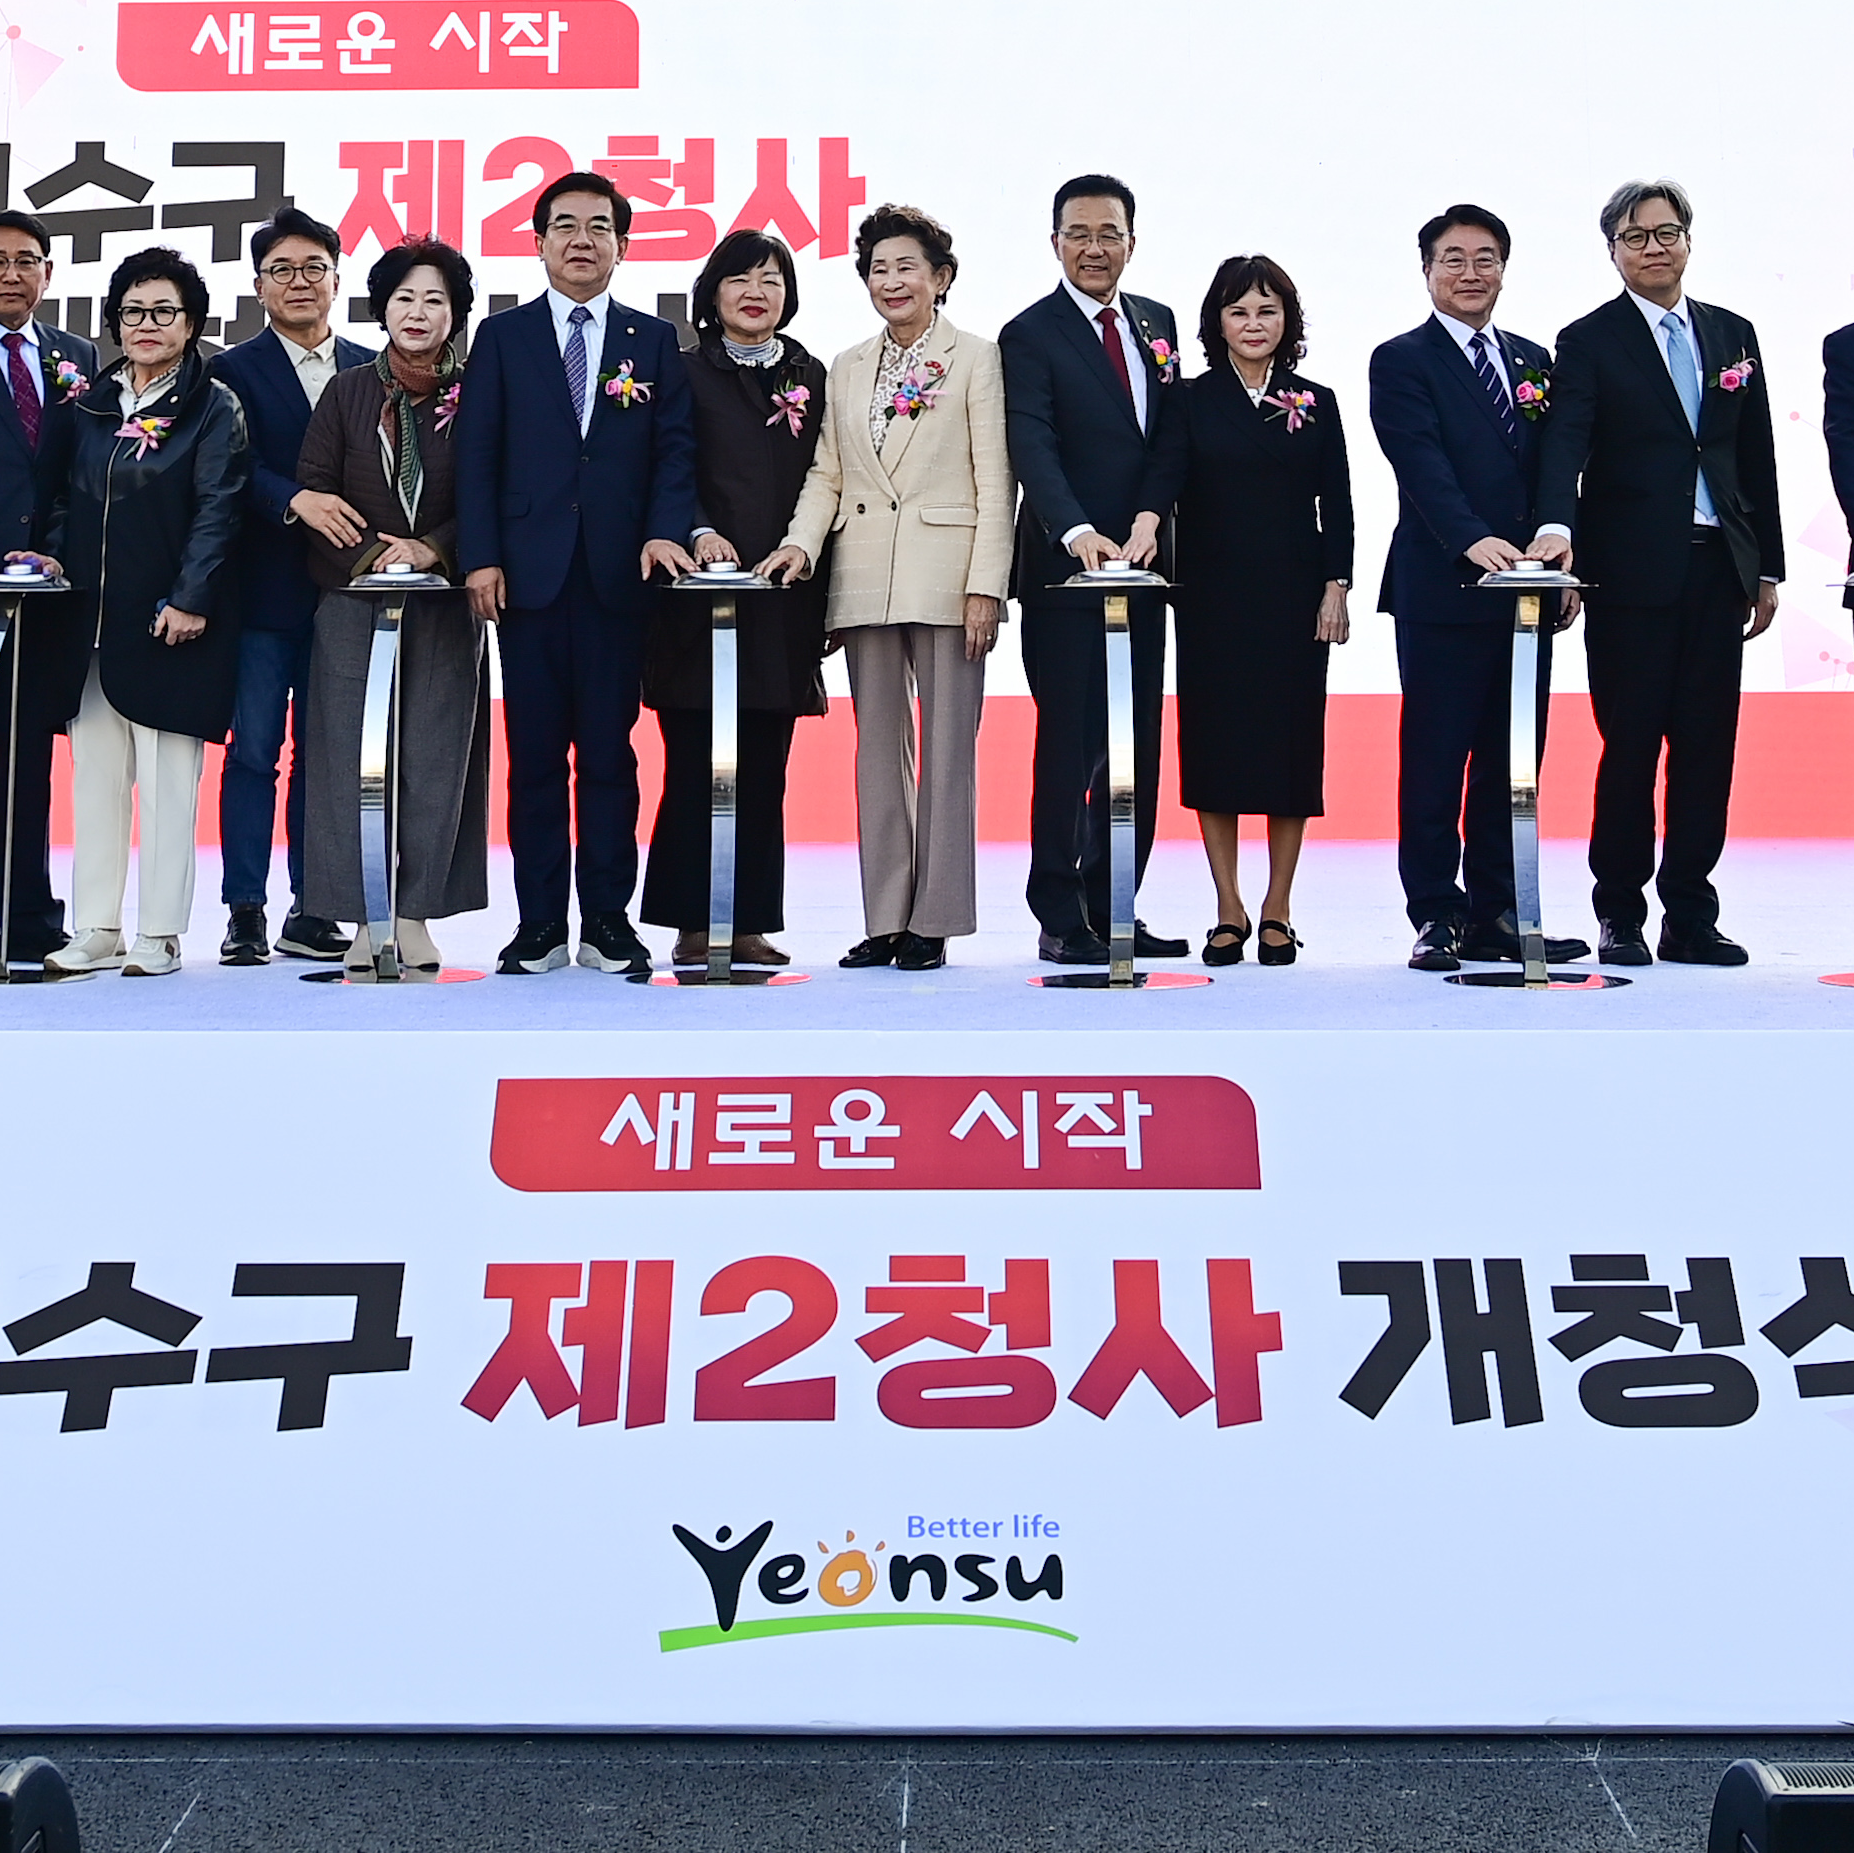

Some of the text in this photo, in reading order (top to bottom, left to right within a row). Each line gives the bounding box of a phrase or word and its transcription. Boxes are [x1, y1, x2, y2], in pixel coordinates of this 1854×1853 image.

[190, 10, 569, 75] 새로운 시작
[338, 135, 866, 261] 제2청사
[599, 1089, 1154, 1172] 새로운 시작
[461, 1254, 1283, 1430] 제2청사
[907, 1513, 1061, 1539] Better life
[671, 1519, 1064, 1633] Yeonsu
